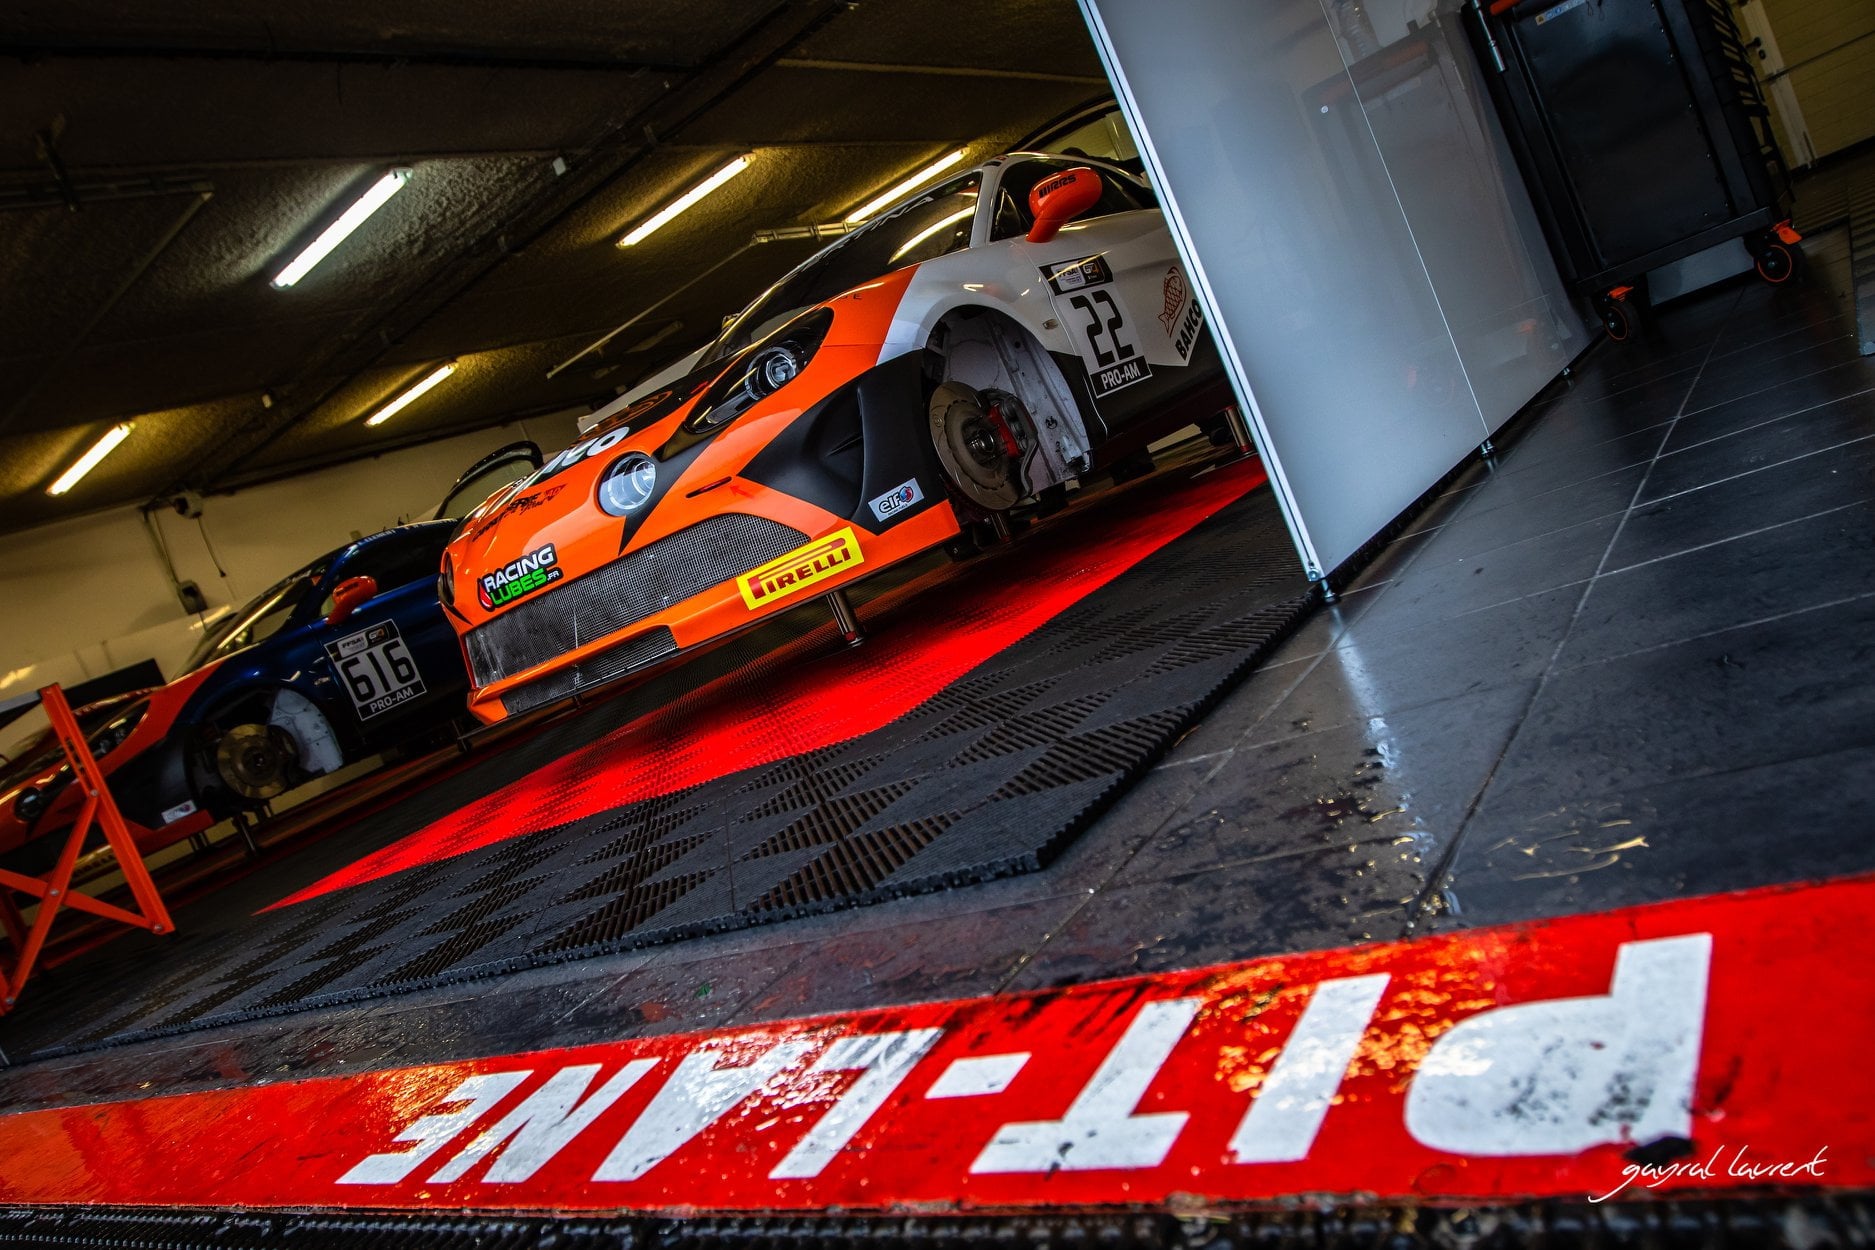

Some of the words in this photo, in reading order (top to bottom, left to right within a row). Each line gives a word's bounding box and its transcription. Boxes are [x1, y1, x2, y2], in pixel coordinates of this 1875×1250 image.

[1069, 289, 1135, 368] 22
[1175, 299, 1202, 361] BAHCO
[1100, 366, 1141, 391] PRO-AM
[483, 546, 555, 593] RACING
[747, 537, 851, 600] PIRELLI
[341, 640, 416, 703] 616
[369, 686, 414, 713] PRO-AM
[335, 931, 1714, 1184] PIT-LANE
